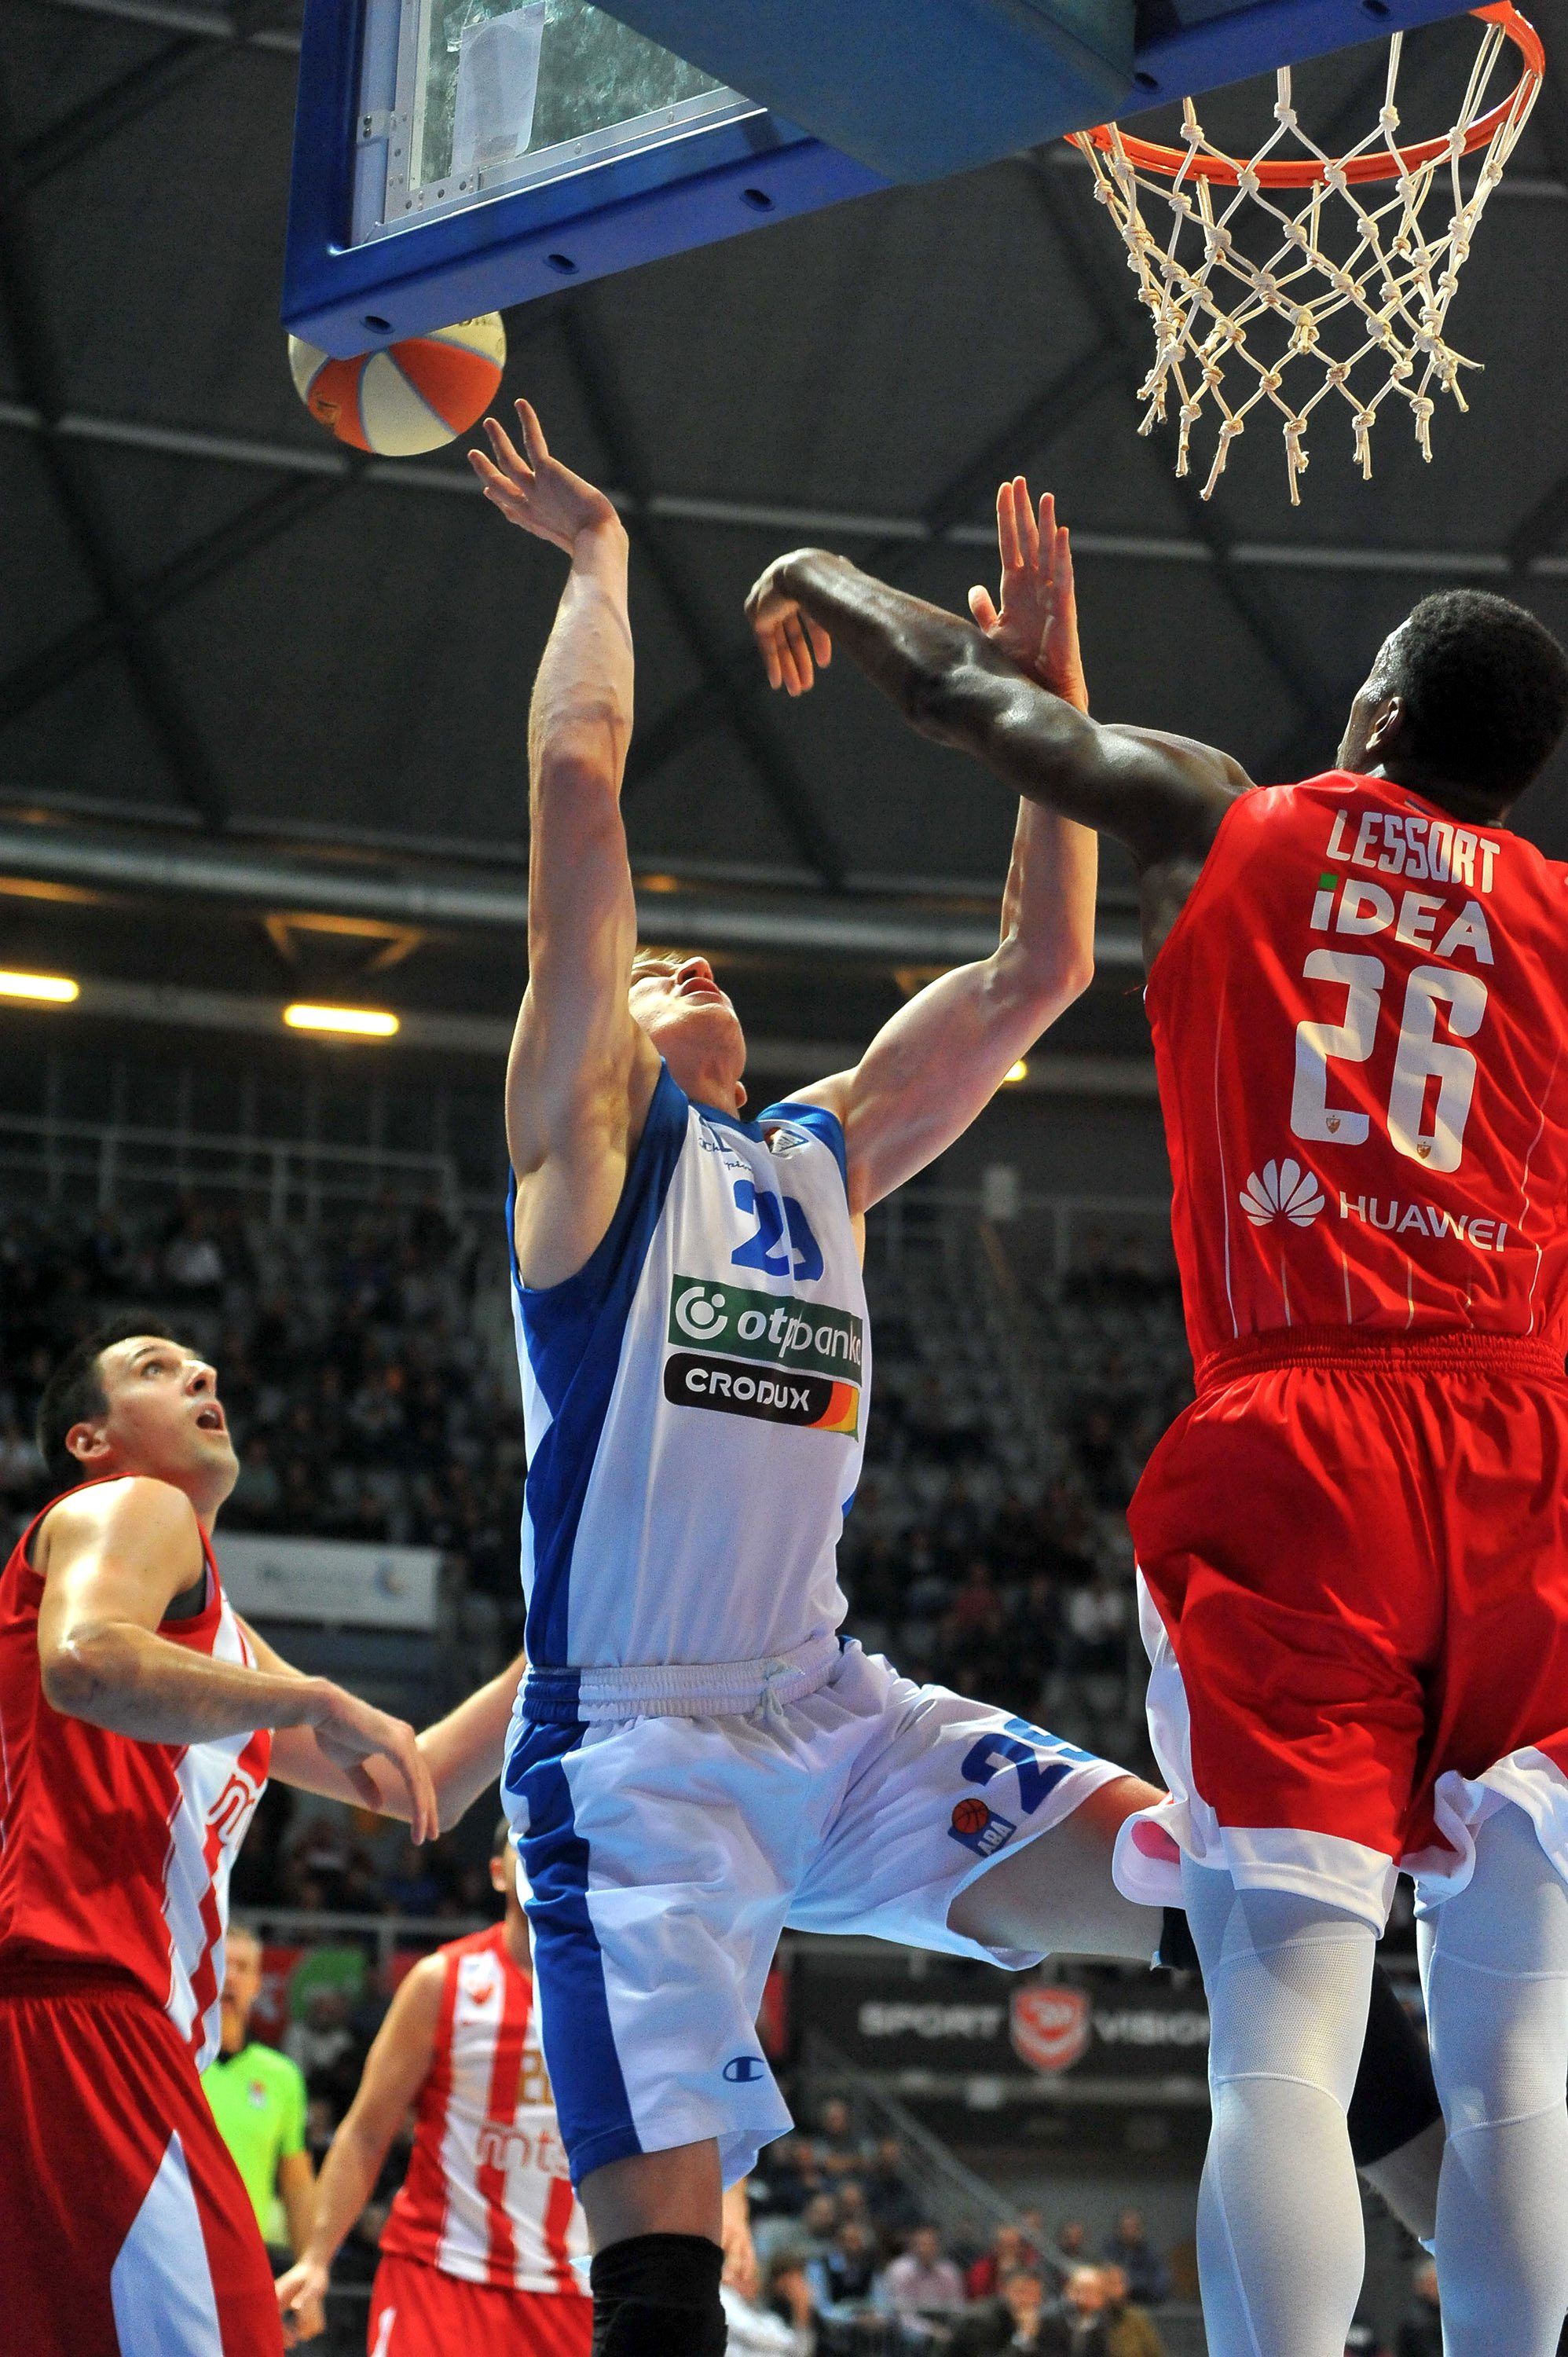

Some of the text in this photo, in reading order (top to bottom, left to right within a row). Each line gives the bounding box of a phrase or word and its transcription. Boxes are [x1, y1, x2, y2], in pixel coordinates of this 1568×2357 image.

[1326, 809, 1500, 893] LESSORT
[1290, 948, 1488, 1173] 26
[1339, 1189, 1508, 1252] HUAWEI
[685, 1367, 811, 1412] CRODUX
[976, 1819, 1013, 1856] ABA
[859, 2001, 1211, 2046] SPORT VISIO
